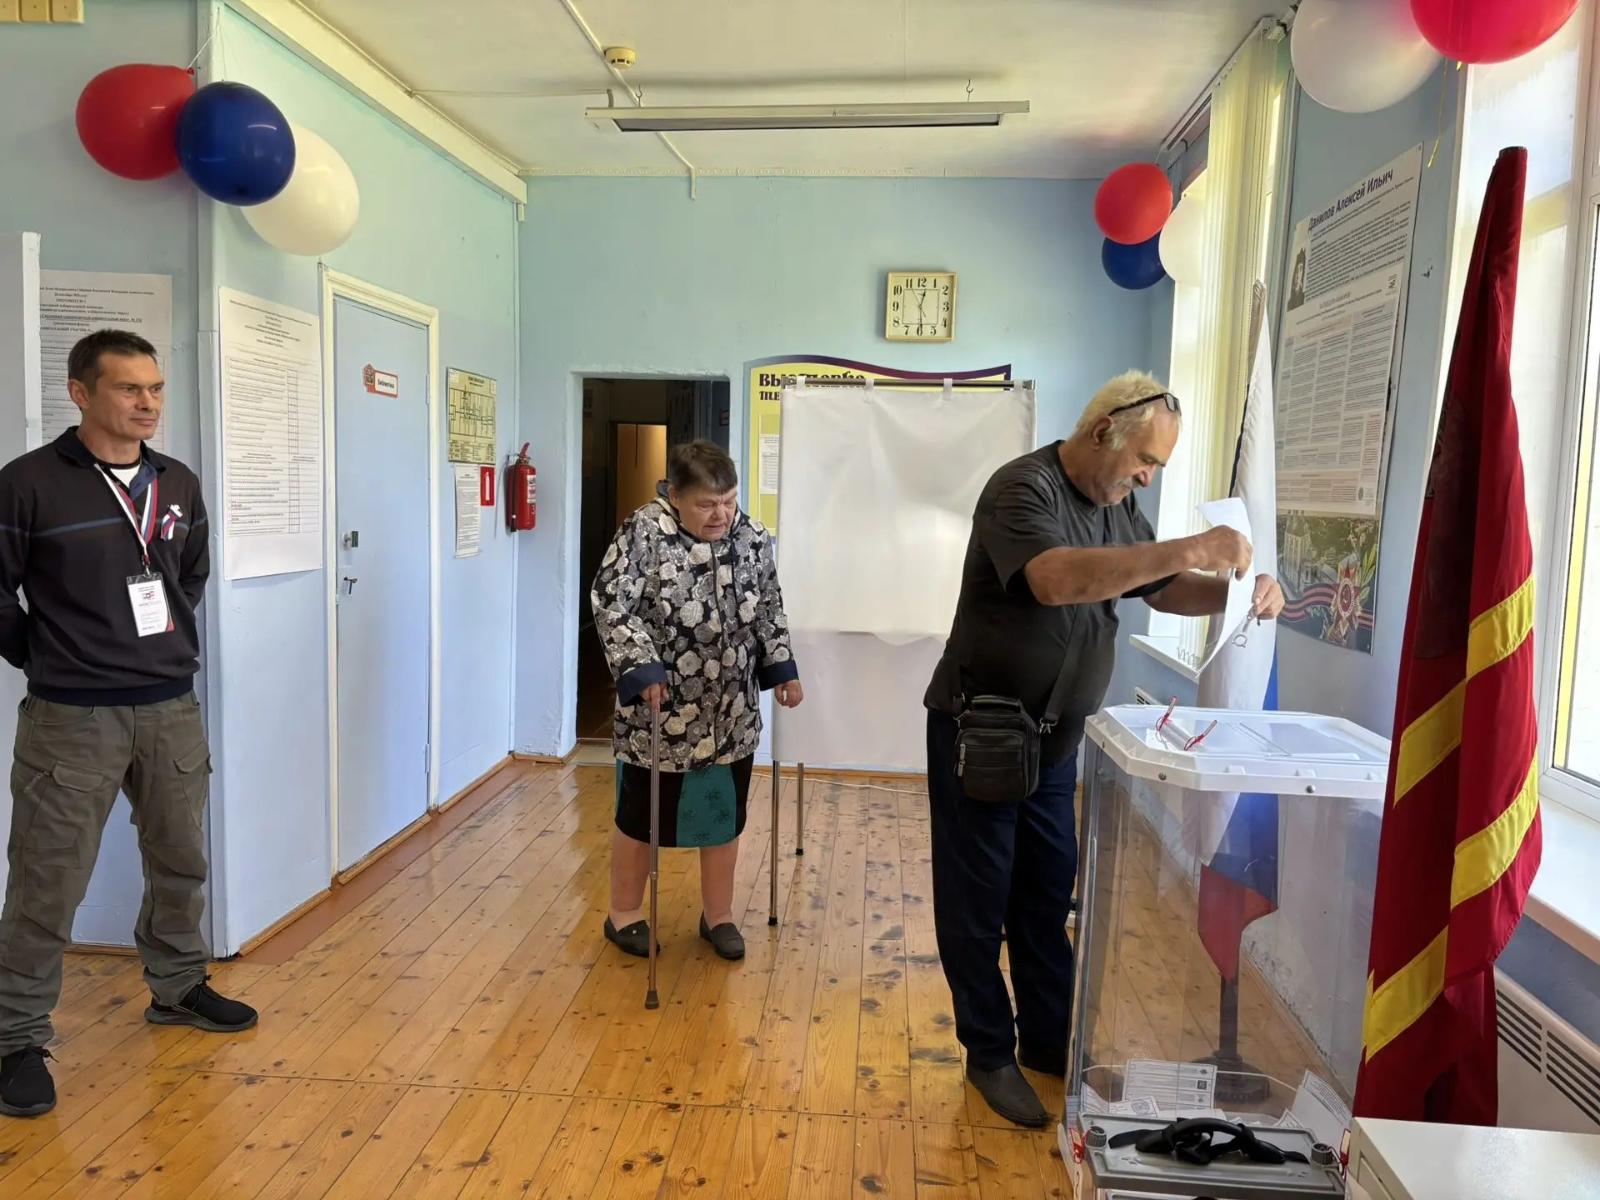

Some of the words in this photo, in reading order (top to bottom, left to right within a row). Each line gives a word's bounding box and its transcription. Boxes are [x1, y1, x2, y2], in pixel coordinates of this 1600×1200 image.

[1336, 182, 1366, 214] Алексей
[1367, 169, 1394, 194] Ильич
[906, 278, 913, 288] 11
[917, 277, 927, 288] 12
[893, 285, 902, 296] 10
[942, 286, 949, 295] 2
[892, 302, 899, 311] 9
[942, 302, 950, 312] 3
[892, 317, 900, 328] 8
[941, 318, 947, 328] 4
[904, 326, 910, 335] 7
[916, 326, 923, 336] 6
[930, 326, 937, 336] 5
